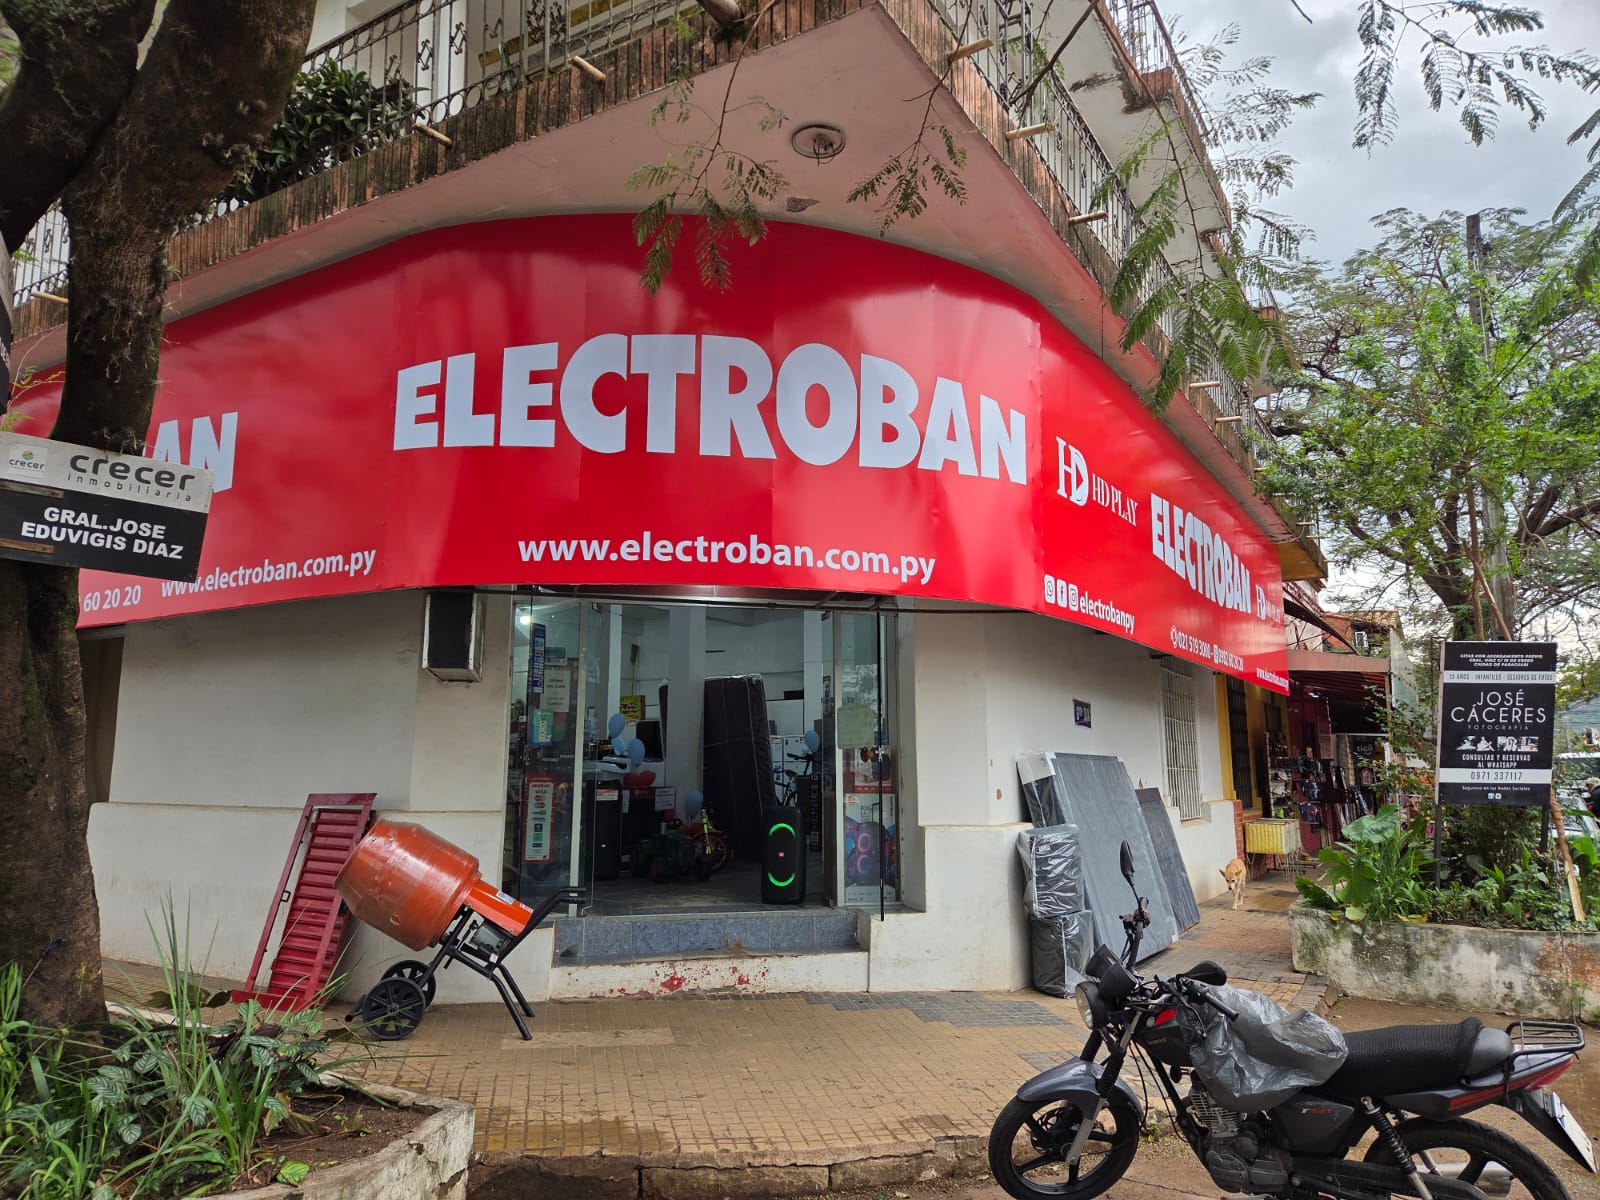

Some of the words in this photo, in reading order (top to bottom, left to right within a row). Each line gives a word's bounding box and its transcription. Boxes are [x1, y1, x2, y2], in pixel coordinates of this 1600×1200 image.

[393, 333, 1027, 486] ELECTROBAN
[9, 459, 45, 469] crecer
[70, 454, 195, 491] crecer
[67, 472, 192, 502] inmobiliaria
[1111, 485, 1139, 527] PLAY
[21, 521, 127, 551] EDUVIGIS
[132, 538, 184, 561] DIAZ
[518, 532, 936, 585] www.electroban.com.py
[1151, 492, 1251, 614] ELECTROBAN
[161, 549, 377, 598] www.electroban.com.py
[83, 591, 100, 612] 60
[102, 588, 121, 610] 20
[123, 585, 142, 606] 20
[1079, 591, 1135, 635] electrobanpy
[1451, 704, 1546, 723] CÁCERES
[1476, 689, 1524, 706] JOSÉ
[1471, 771, 1490, 780] 0971
[1494, 771, 1522, 781] 337117
